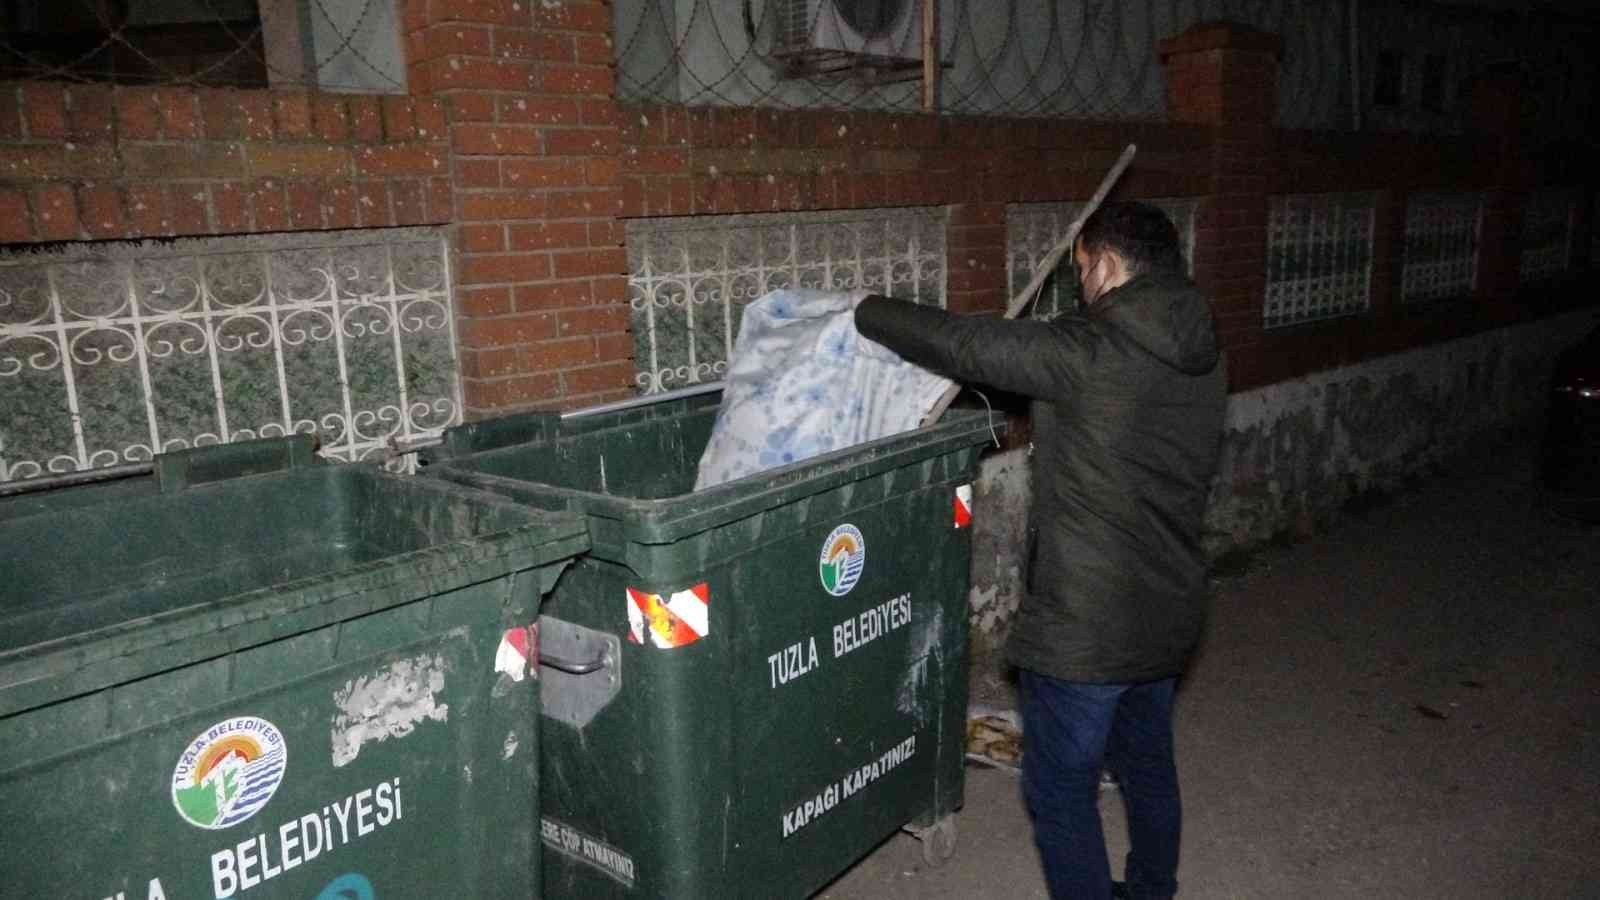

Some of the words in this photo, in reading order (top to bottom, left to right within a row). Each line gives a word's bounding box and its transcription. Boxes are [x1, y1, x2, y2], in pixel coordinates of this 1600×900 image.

[767, 636, 819, 689] TUZLA
[175, 739, 207, 784] TUZLA
[842, 735, 916, 799] KAPATINIZ!
